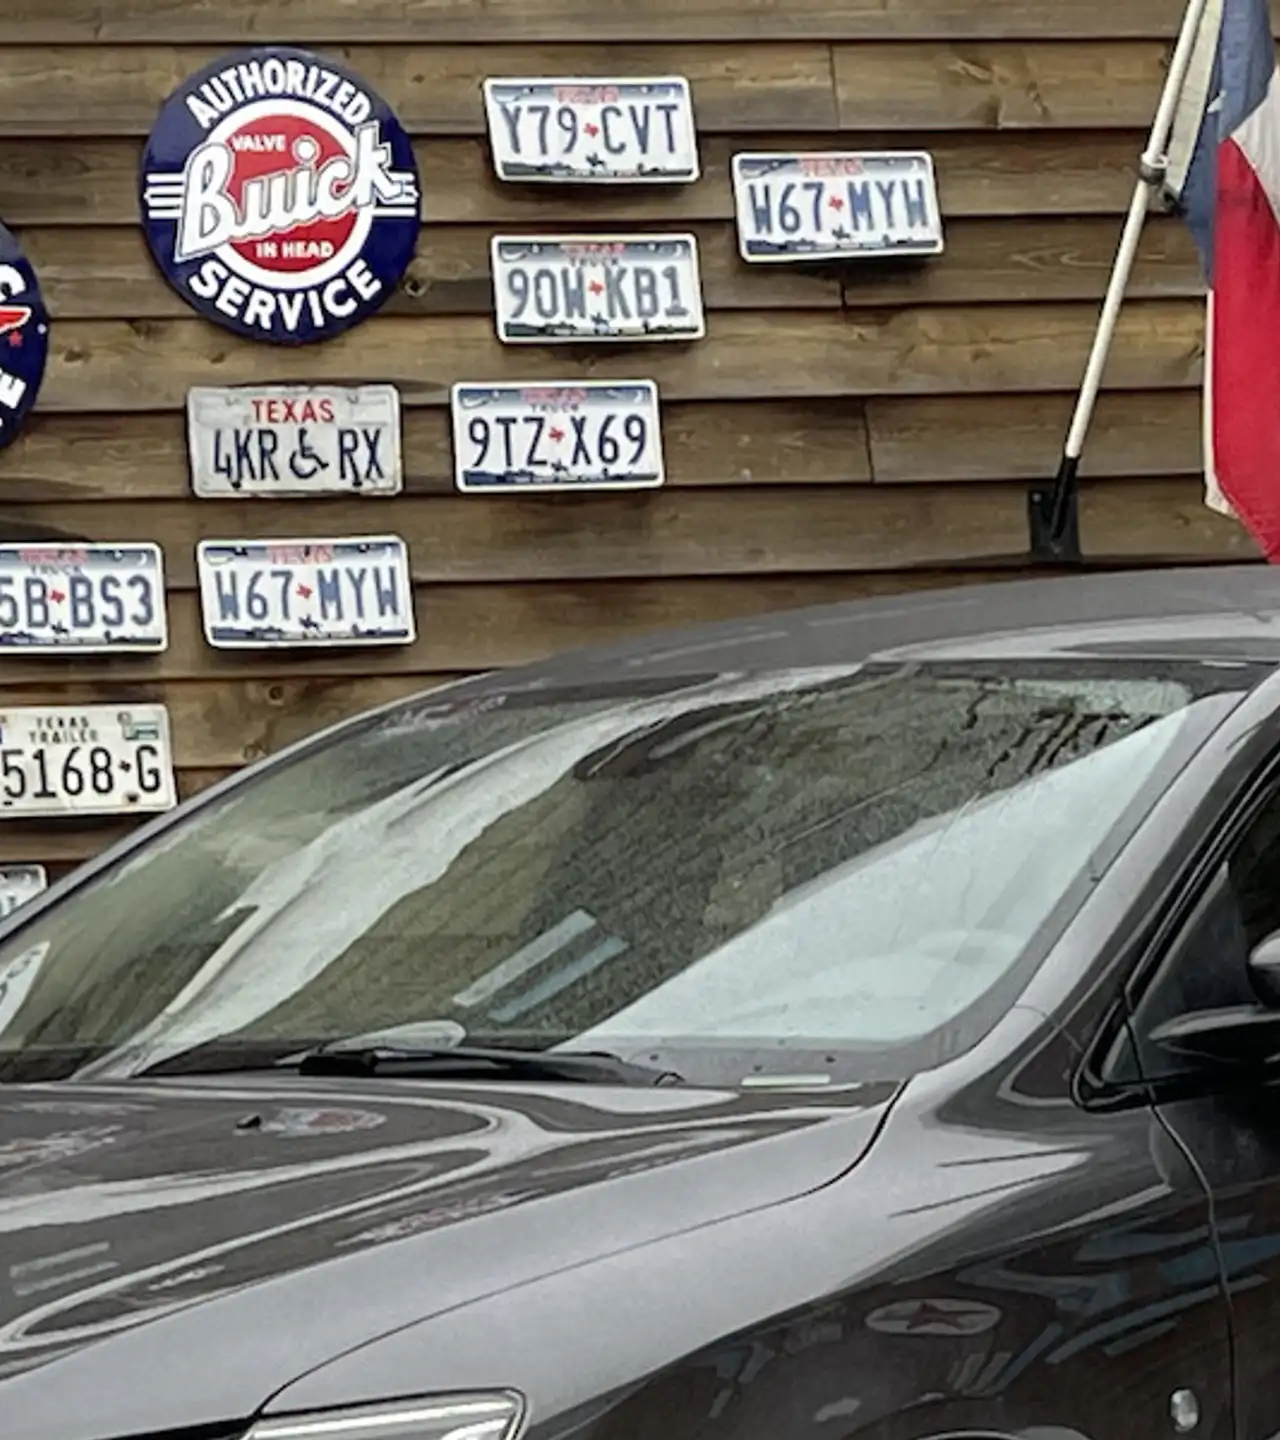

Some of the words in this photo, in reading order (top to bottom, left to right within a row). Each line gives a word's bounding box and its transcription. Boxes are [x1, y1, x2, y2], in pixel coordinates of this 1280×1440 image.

[185, 58, 372, 128] AUTHORIZED
[232, 134, 286, 152] VALVE
[174, 120, 404, 263] Buick
[256, 243, 279, 258] IN
[282, 243, 335, 259] HEAD
[188, 259, 382, 331] SERVICE
[251, 399, 335, 424] TEXAS
[214, 428, 279, 481] 4KR
[338, 428, 384, 480] RX
[36, 717, 90, 729] TEXAS
[28, 730, 99, 745] TRAILER
